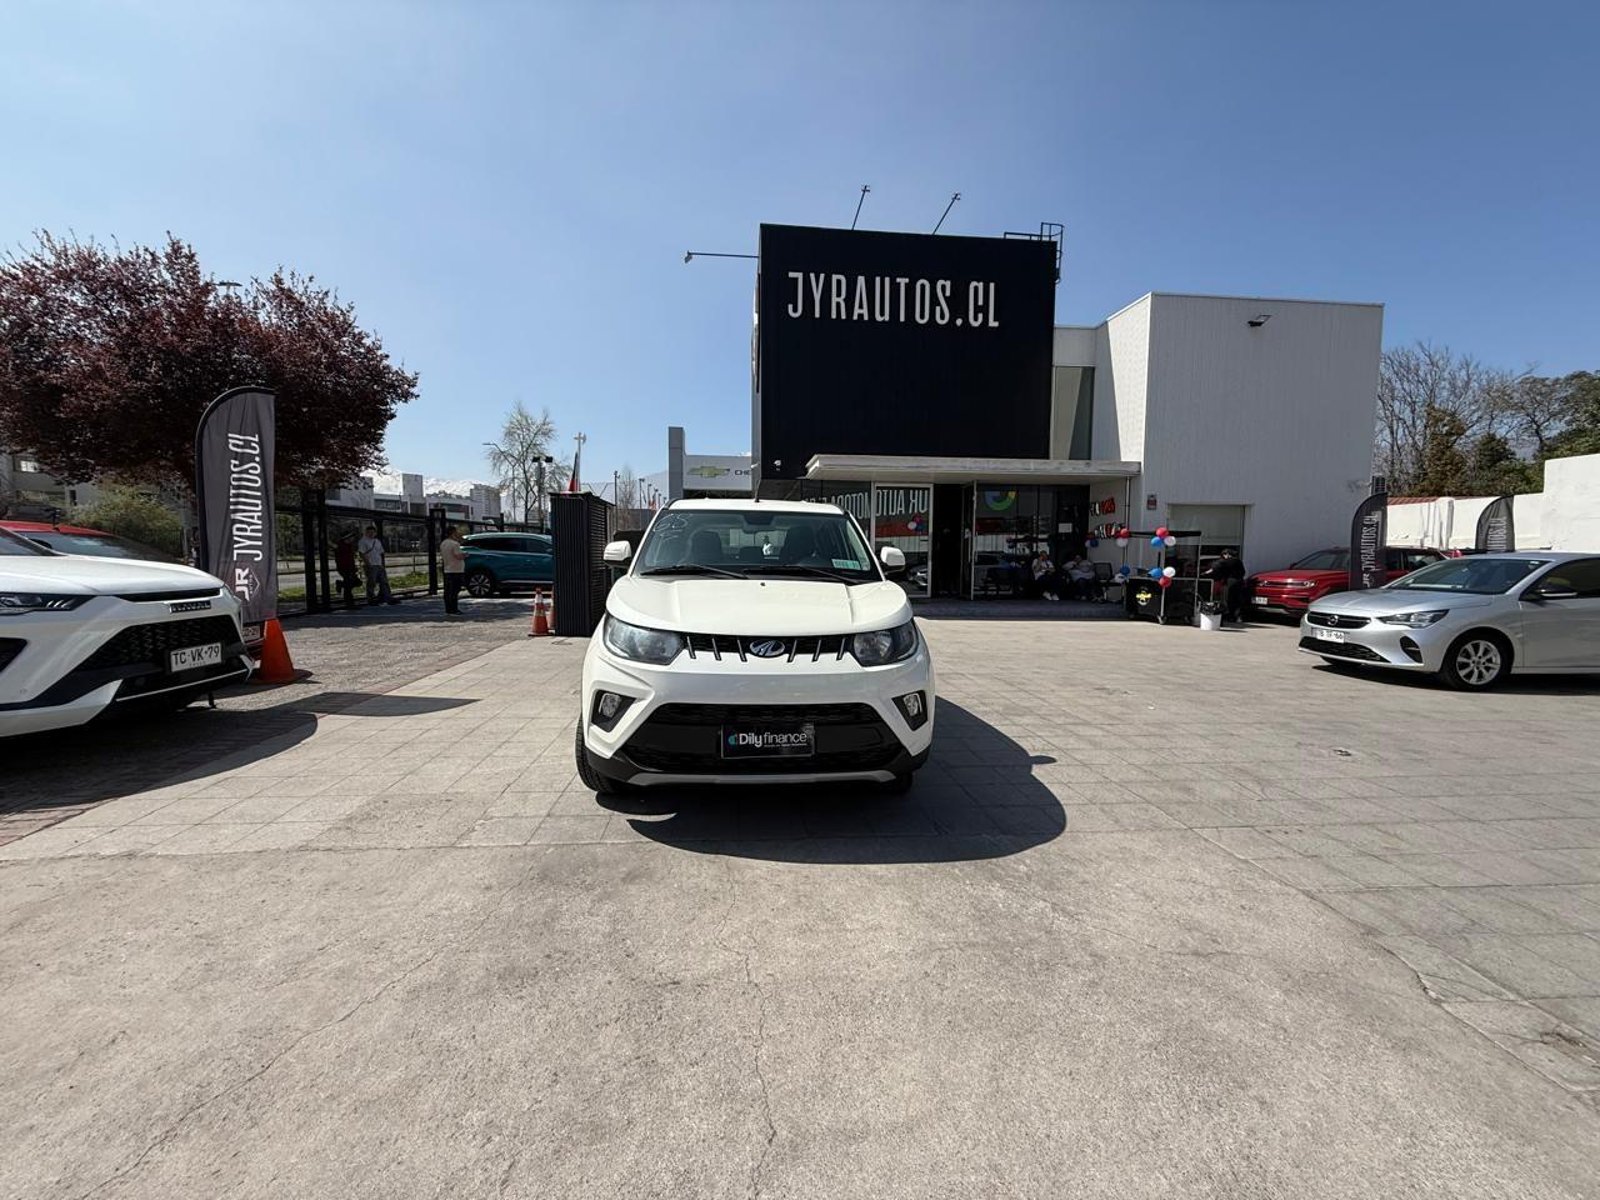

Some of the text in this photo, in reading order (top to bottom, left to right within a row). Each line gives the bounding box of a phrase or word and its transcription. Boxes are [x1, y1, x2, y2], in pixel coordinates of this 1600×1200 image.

[788, 271, 999, 327] JYRAUTOS.CL
[228, 433, 263, 561] JYRAUTOS.CL
[1361, 514, 1377, 571] JYRAUTOS.CL
[1487, 517, 1507, 553] UTOS.CL
[235, 568, 249, 601] JR
